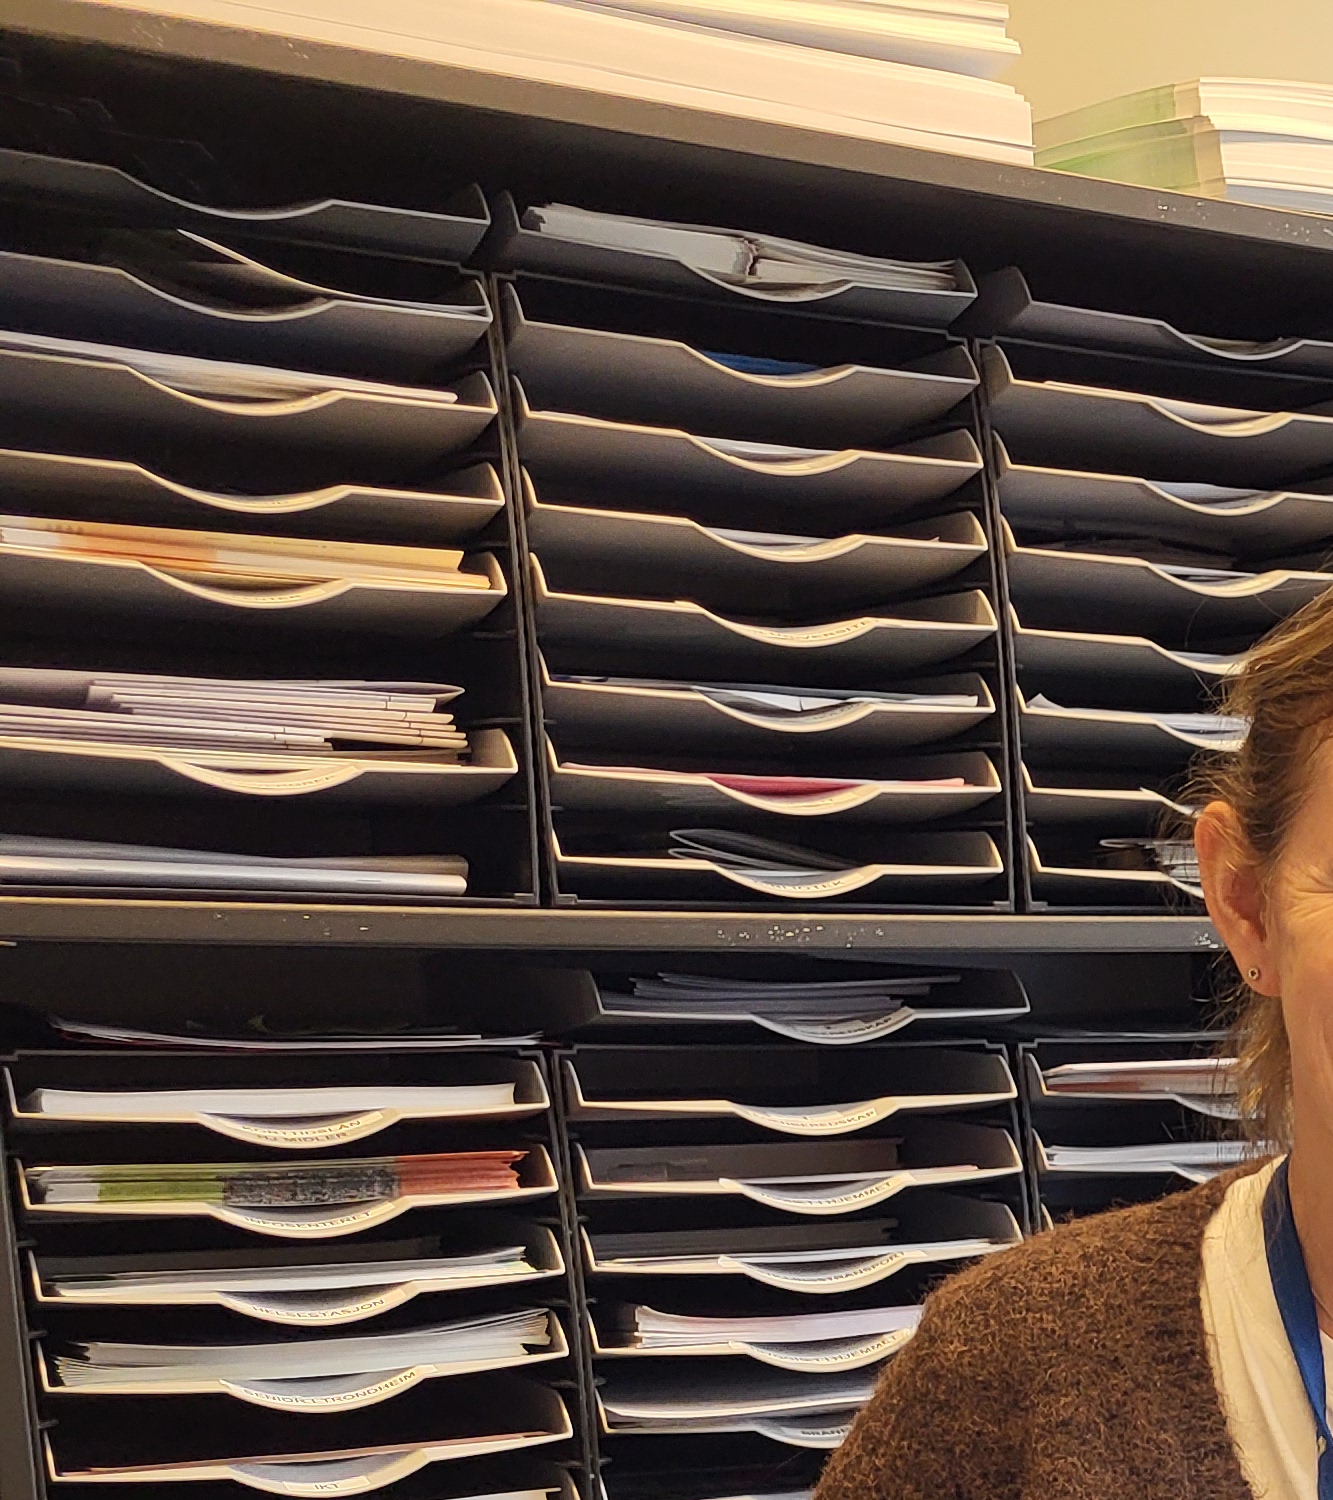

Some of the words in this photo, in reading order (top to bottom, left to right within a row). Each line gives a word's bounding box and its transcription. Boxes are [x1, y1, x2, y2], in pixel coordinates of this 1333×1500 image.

[251, 1298, 385, 1318] HELSESTASJON
[321, 1371, 416, 1404] TRONDHEIM
[315, 1482, 340, 1491] IKT
